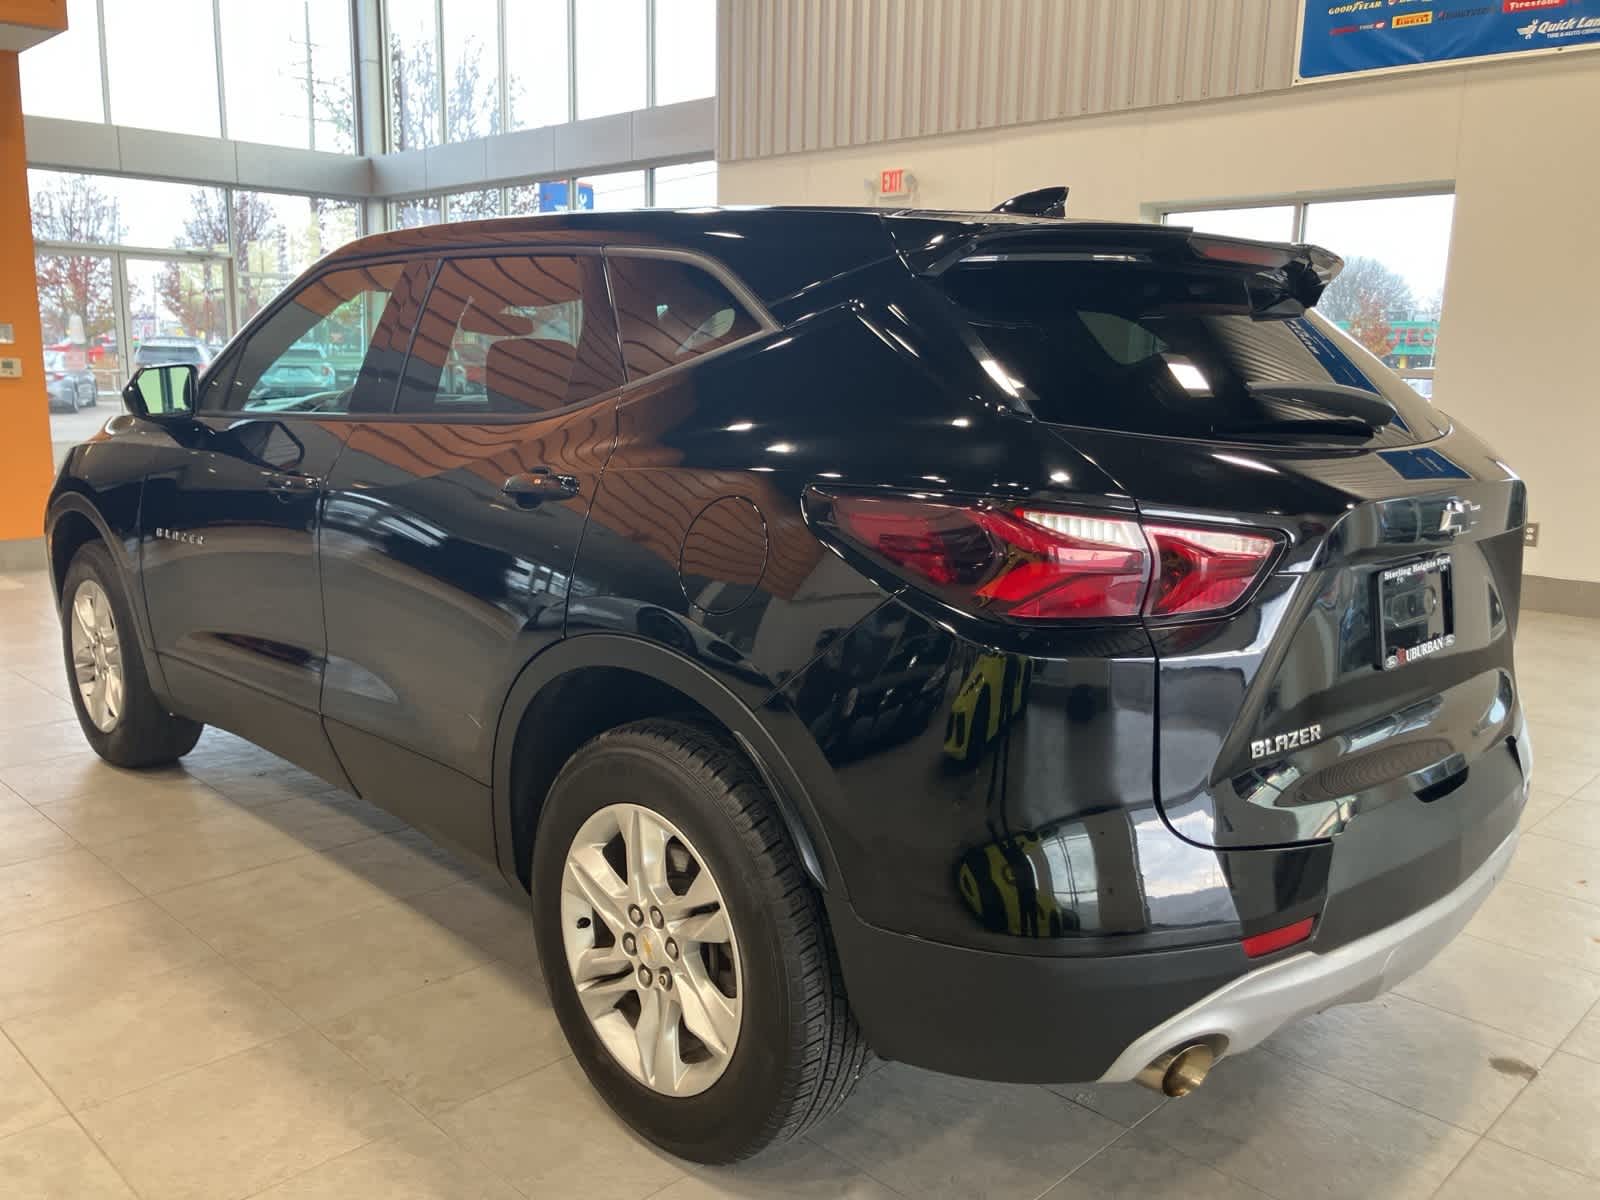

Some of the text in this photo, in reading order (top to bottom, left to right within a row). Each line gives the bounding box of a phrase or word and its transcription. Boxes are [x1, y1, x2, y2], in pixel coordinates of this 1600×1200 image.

[1328, 1, 1383, 15] GOODYEAR
[1395, 14, 1430, 26] PIRELLI
[1538, 18, 1577, 34] Quick
[881, 169, 904, 192] EXIT
[1384, 555, 1451, 580] Sterling Heights Ford
[1251, 724, 1321, 759] BLAZER
